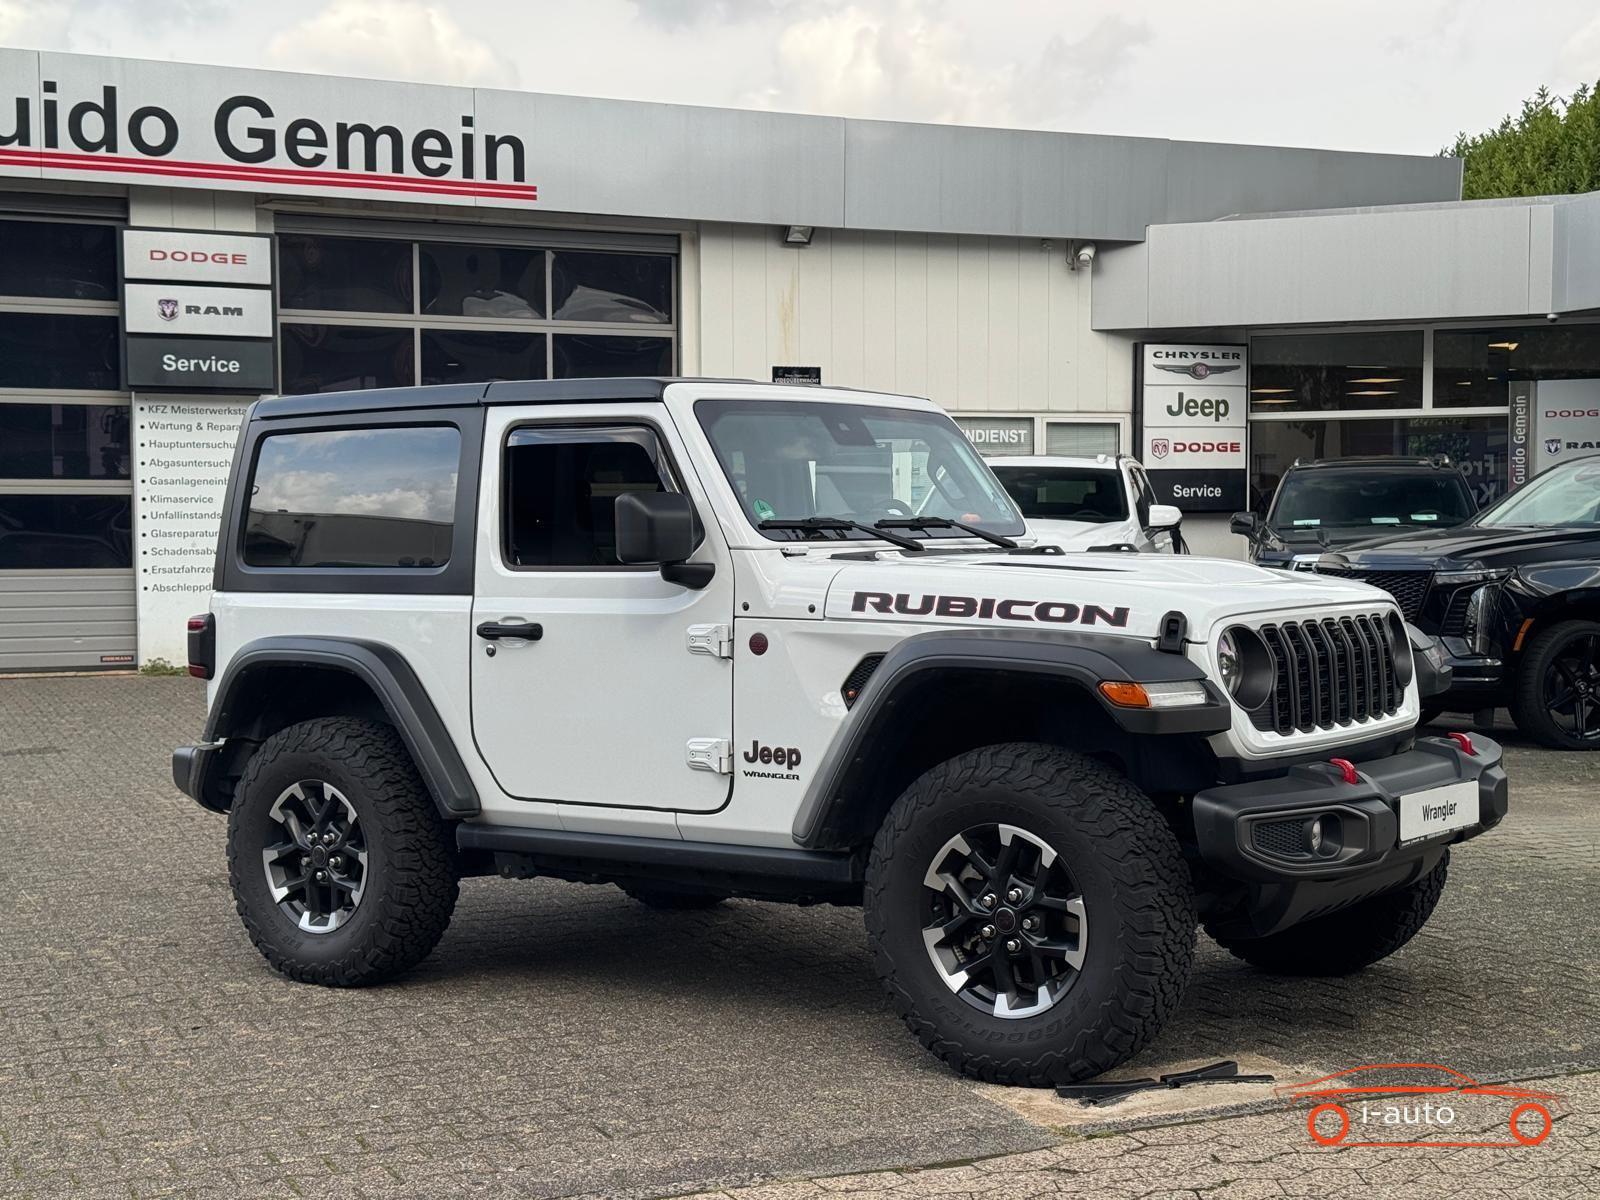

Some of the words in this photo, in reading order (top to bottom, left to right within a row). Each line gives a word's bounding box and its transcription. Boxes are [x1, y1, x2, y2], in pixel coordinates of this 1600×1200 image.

[0, 80, 180, 157] uido
[213, 95, 525, 183] Gemein
[150, 250, 247, 265] DODGE
[185, 305, 244, 316] RAM
[1152, 351, 1241, 360] CHRYSLER
[162, 354, 240, 373] Service
[148, 405, 168, 414] KFZ
[171, 405, 247, 415] Meisterwerksta
[1166, 392, 1230, 422] Jeep
[1513, 395, 1526, 444] Gemein
[1545, 409, 1599, 418] DODG
[148, 421, 193, 432] Wartung
[196, 422, 203, 431] &
[961, 429, 1028, 443] NDIENST
[1173, 442, 1241, 453] DODGE
[149, 458, 231, 469] Abgasuntersuch
[1512, 448, 1526, 485] Guido
[1173, 484, 1222, 498] Service
[150, 495, 214, 504] Klimaservice
[150, 529, 219, 540] Glasreparatur
[151, 583, 212, 593] Abschleppd
[851, 591, 1130, 628] RUBICON
[743, 740, 802, 770] Jeep
[743, 770, 800, 780] WRANGLER
[1422, 800, 1457, 821] Wrangler
